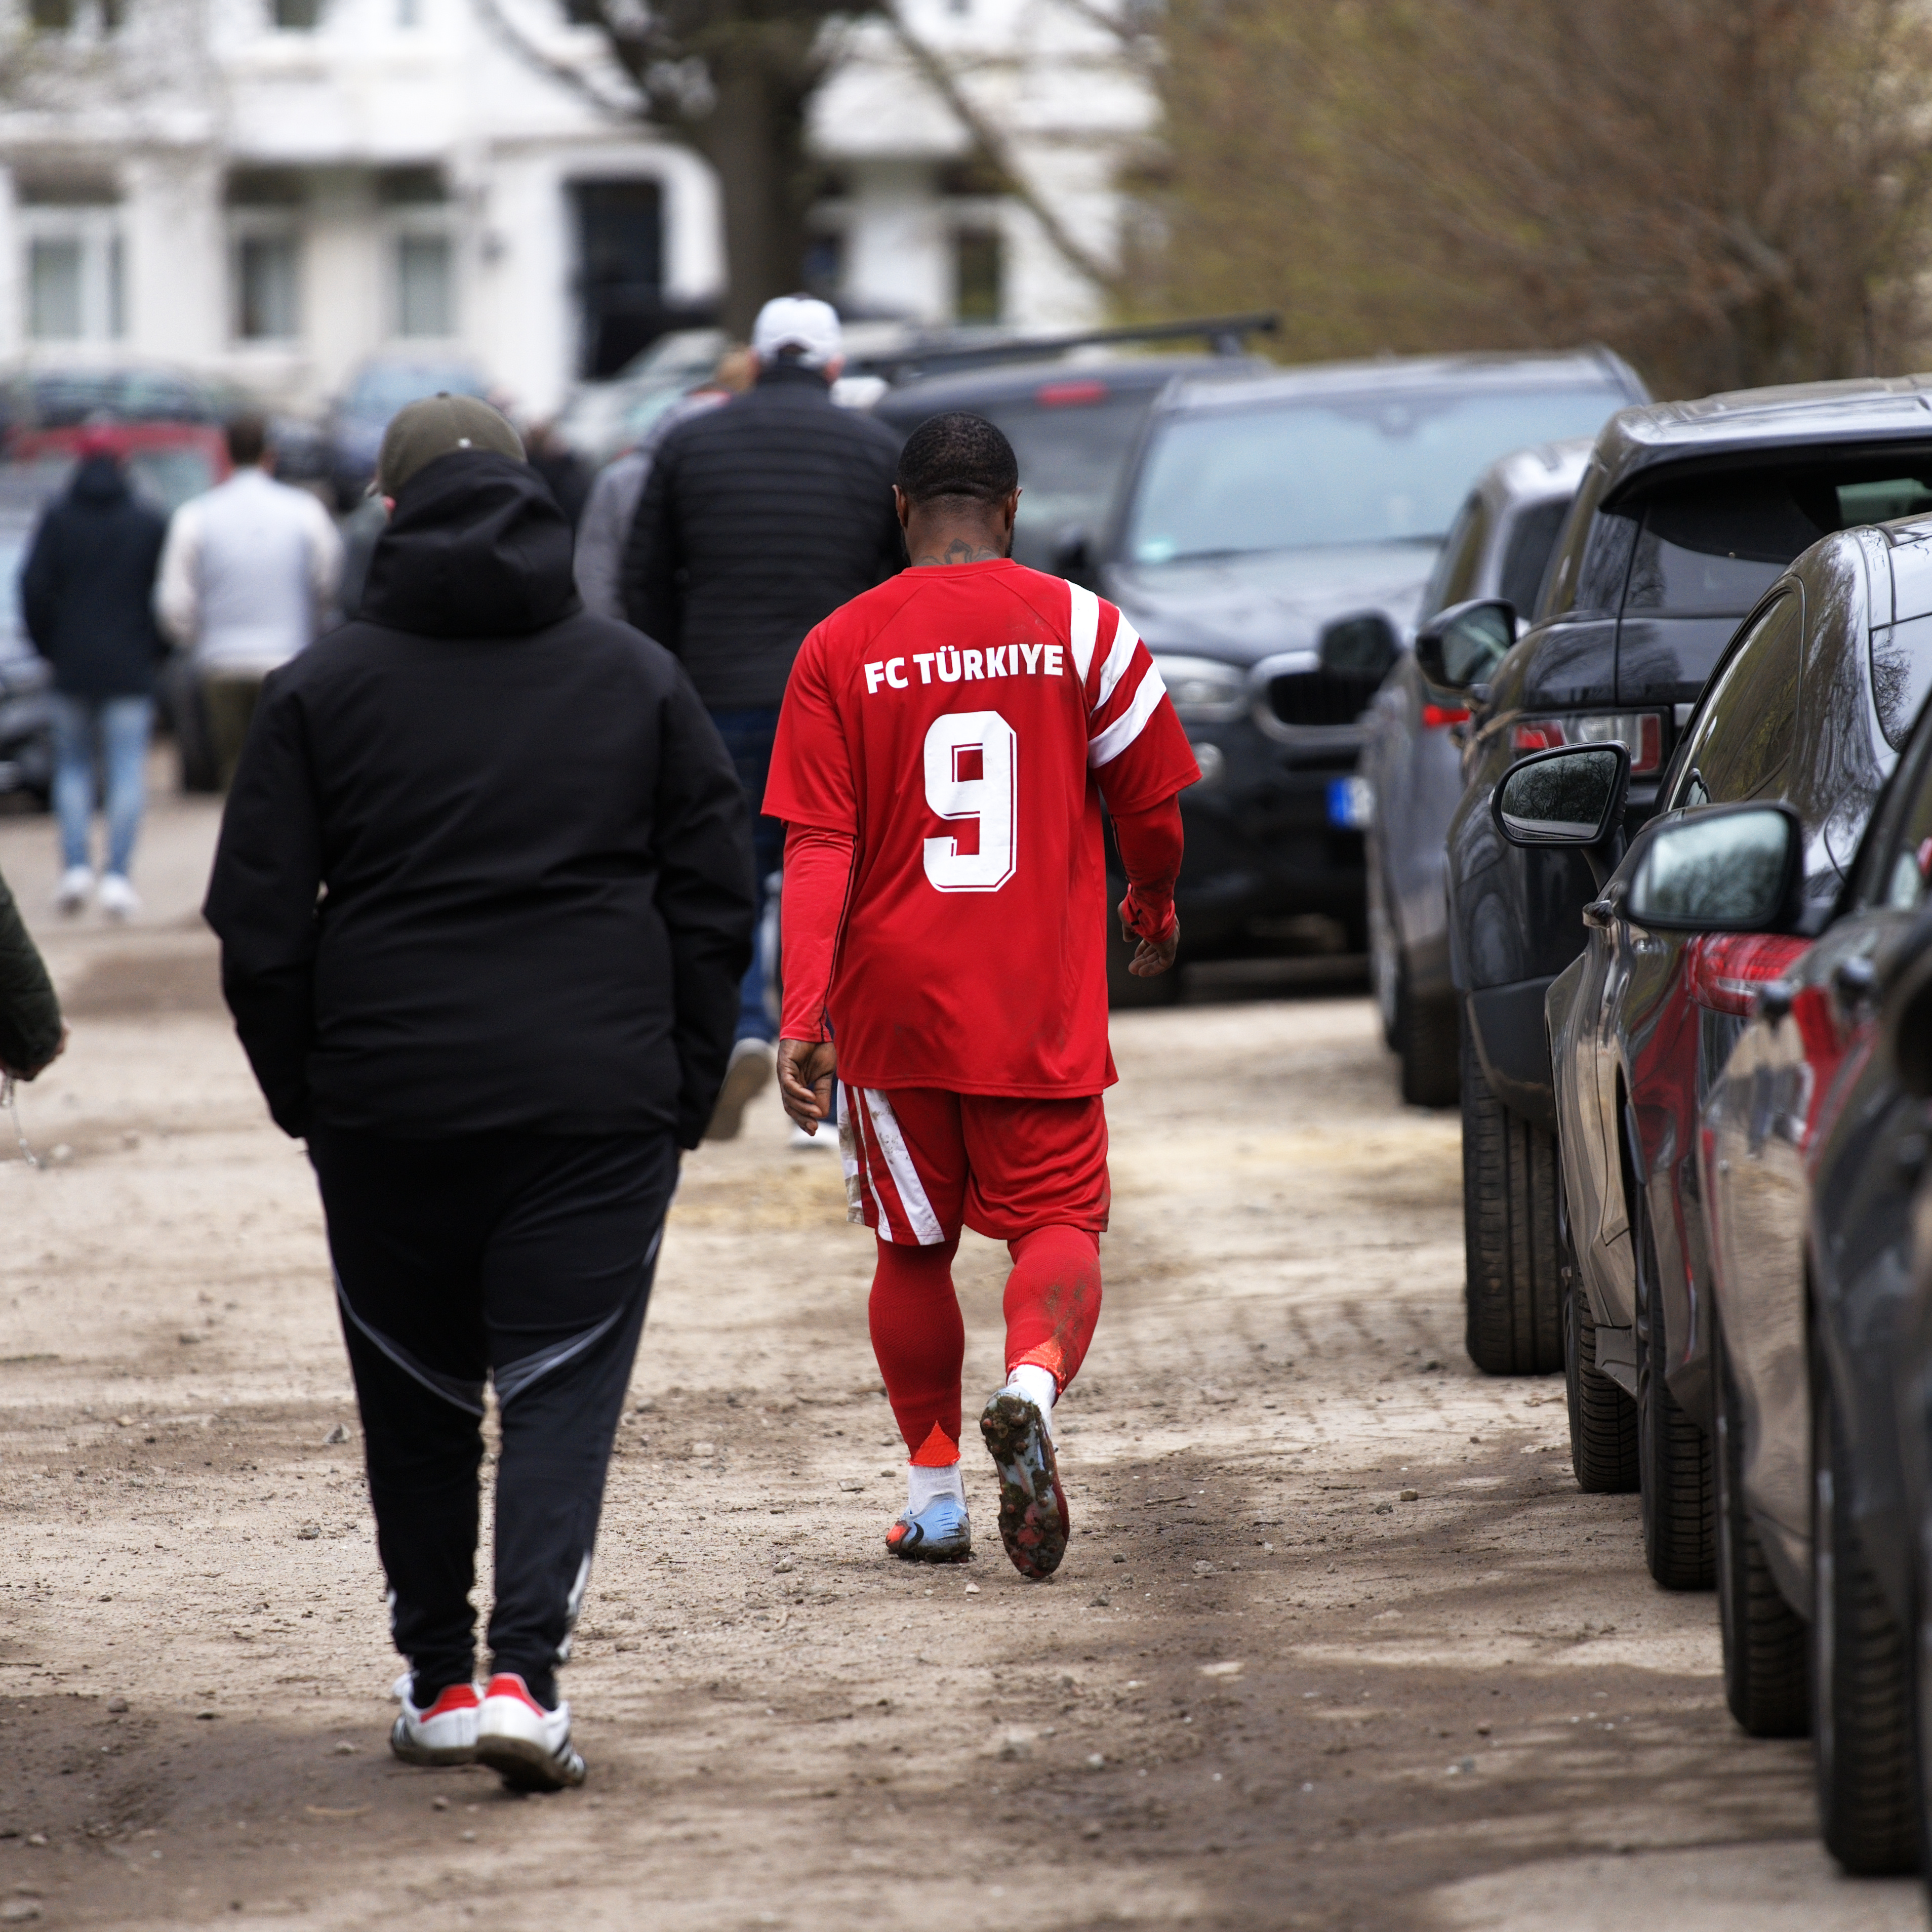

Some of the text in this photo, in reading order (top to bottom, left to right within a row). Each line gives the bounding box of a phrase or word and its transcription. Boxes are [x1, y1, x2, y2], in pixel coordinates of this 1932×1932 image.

[864, 644, 1063, 694] FC TÜRKIYE
[923, 710, 1017, 893] 9
